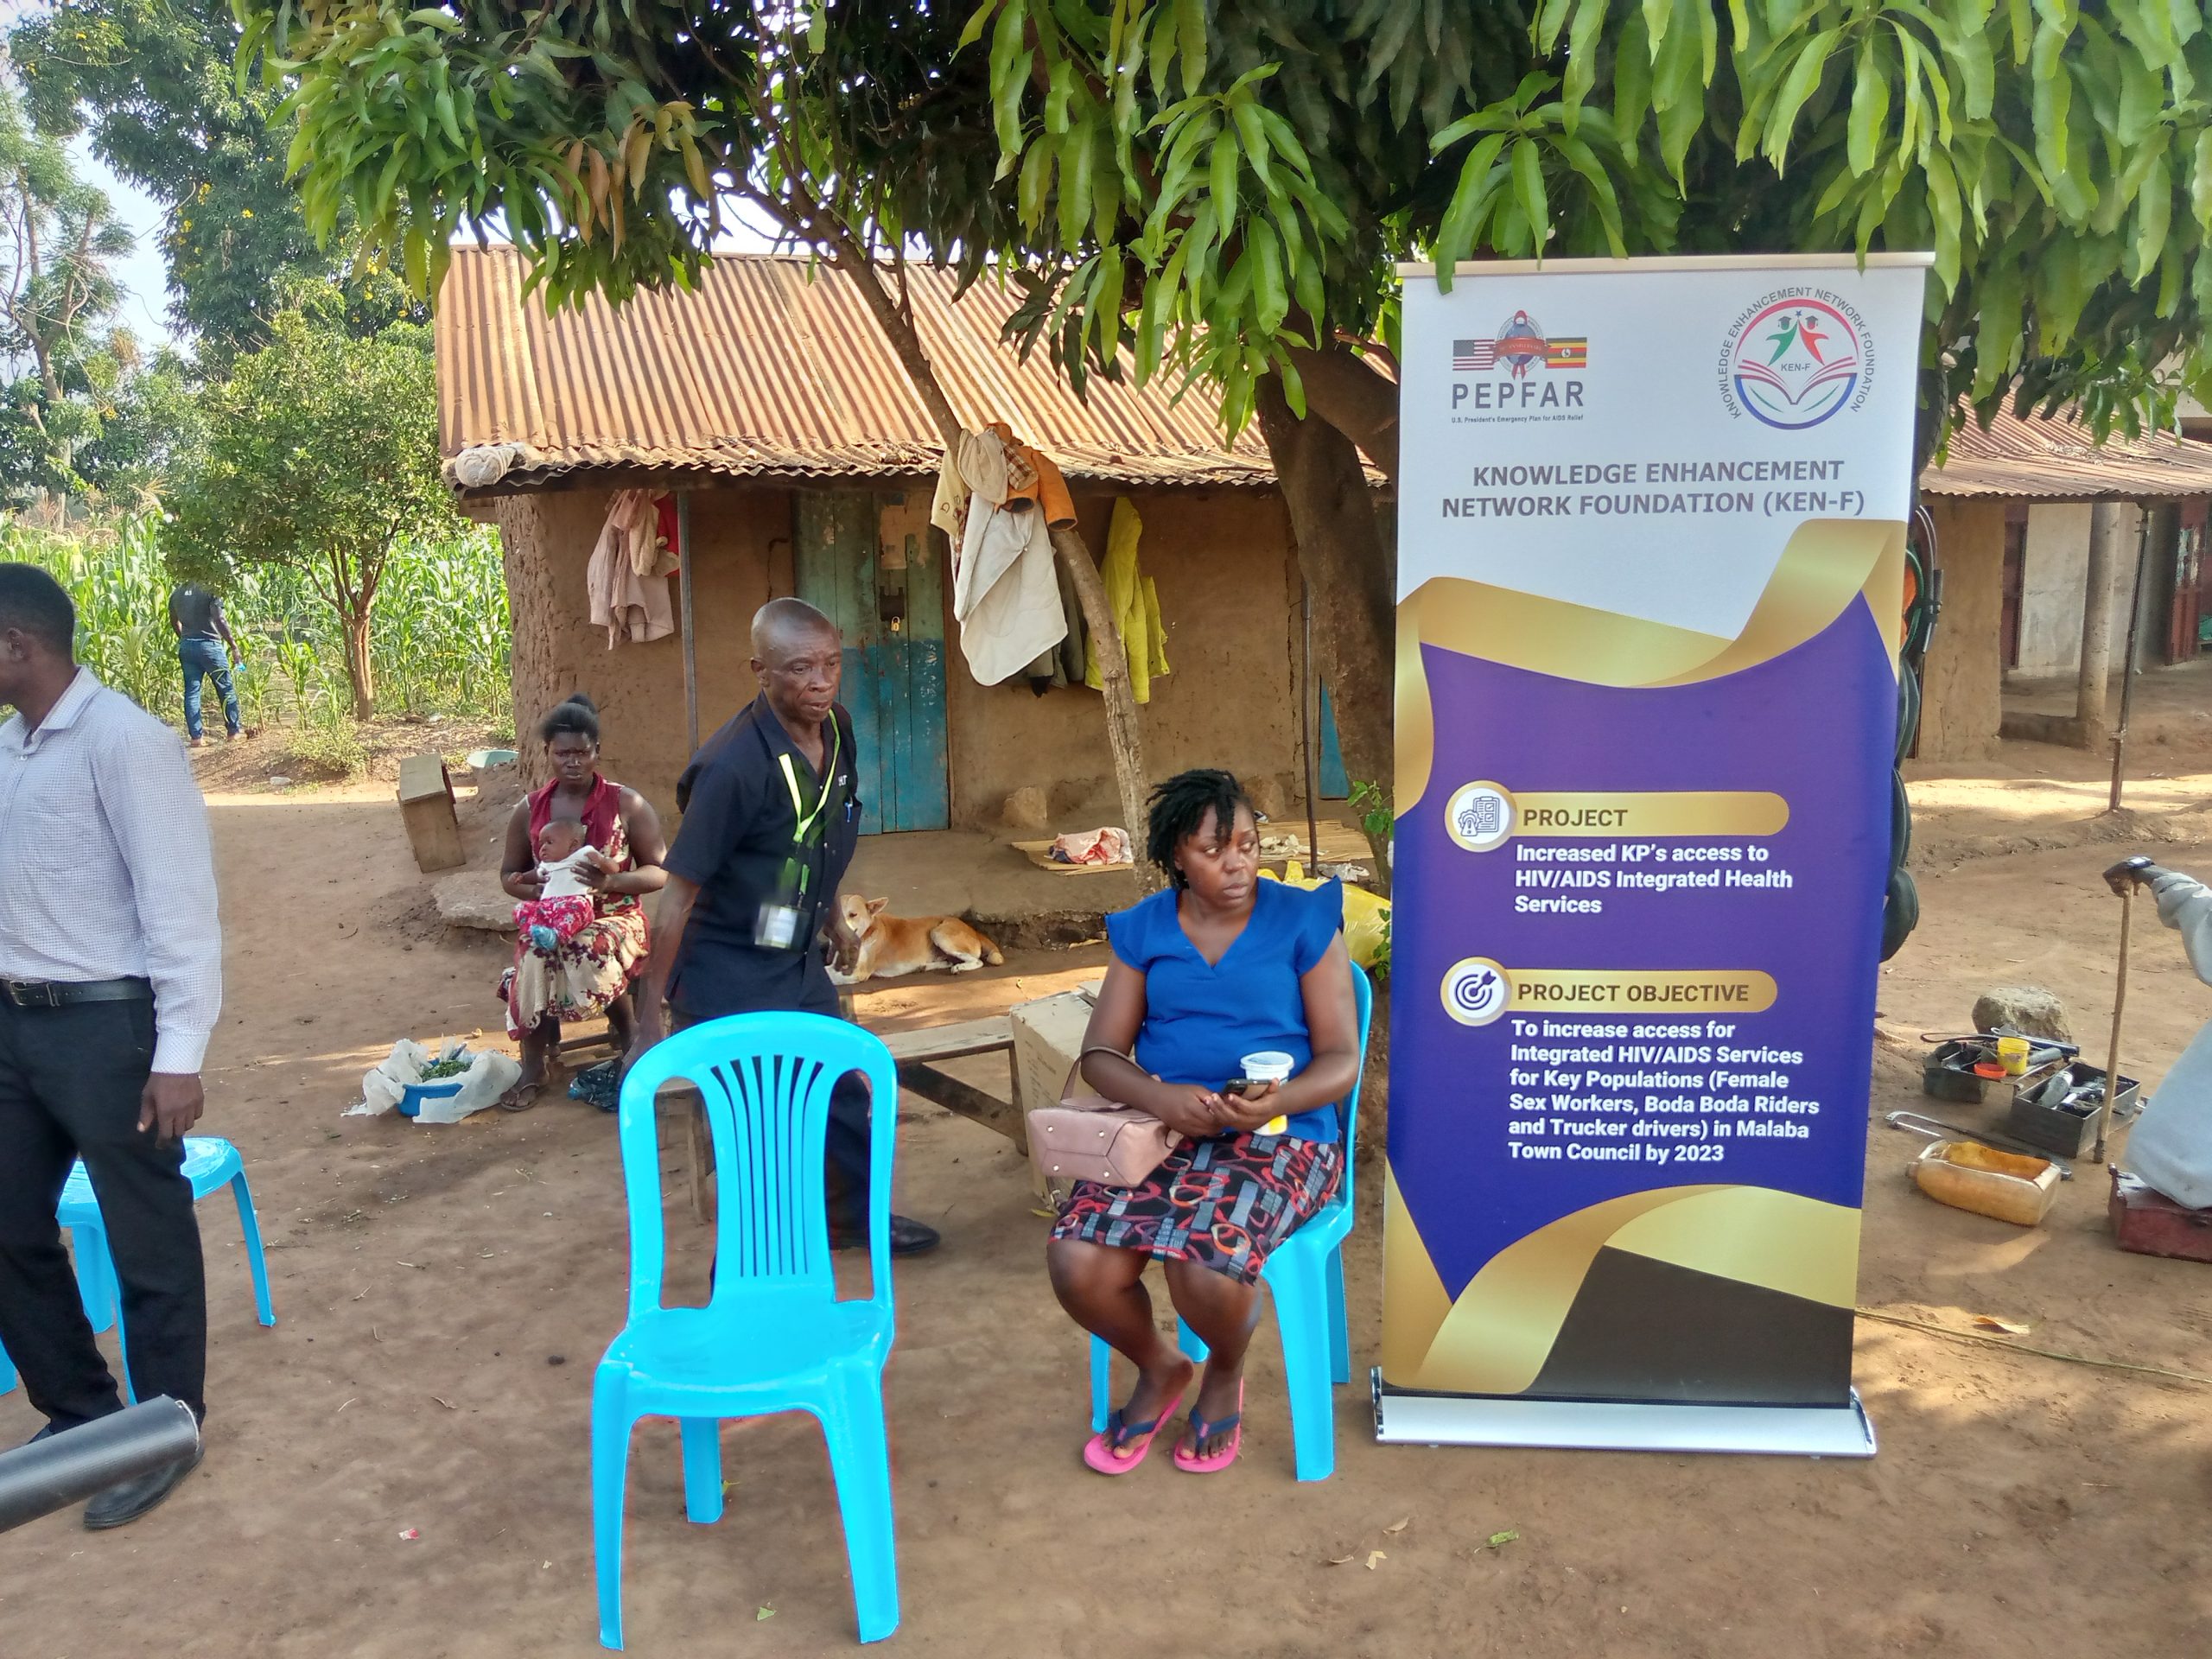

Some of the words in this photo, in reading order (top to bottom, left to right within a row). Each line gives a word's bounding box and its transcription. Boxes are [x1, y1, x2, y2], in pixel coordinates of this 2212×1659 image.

[1728, 287, 1812, 338] ENHANCEMENT
[1815, 289, 1866, 331] NETWORK
[1718, 340, 1741, 419] KNOWLEDGE
[1850, 332, 1874, 412] FOUNDATION
[1452, 380, 1584, 410] PEPFAR
[1473, 463, 1637, 486] KNOWLEDGE
[1645, 460, 1845, 483] ENHANCEMENT
[1442, 495, 1572, 518] NETWORK
[1580, 492, 1754, 515] FOUNDATION
[1763, 490, 1865, 518] (KEN-F)
[1523, 809, 1629, 827] PROJECT
[1516, 843, 1617, 862] Increased
[1621, 843, 1668, 862] KP's
[1671, 847, 1743, 861] access
[1746, 844, 1770, 861] to
[1515, 869, 1611, 888] HIV/AIDS
[1616, 868, 1720, 892] Integrated
[1725, 869, 1793, 888] Health
[1514, 894, 1602, 913] Services
[1517, 983, 1621, 1001] PROJECT
[1626, 984, 1750, 1002] OBJECTIVE
[1510, 1019, 1539, 1037] To
[1542, 1019, 1629, 1039] increase
[1632, 1025, 1702, 1039] access
[1706, 1020, 1736, 1039] for
[1510, 1044, 1614, 1066] Integrated
[1618, 1046, 1712, 1065] HIV/AIDS
[1716, 1046, 1803, 1065] Services
[1509, 1067, 1540, 1086] for
[1543, 1069, 1582, 1091] Key
[1586, 1070, 1704, 1091] Populations
[1708, 1070, 1789, 1092] (Female
[1509, 1093, 1547, 1111] Sex
[1551, 1094, 1639, 1116] Workers,
[1644, 1095, 1695, 1113] Boda
[1700, 1094, 1750, 1113] Boda
[1754, 1095, 1820, 1115] Riders
[1508, 1117, 1546, 1135] and
[1549, 1118, 1628, 1136] Trucker
[1631, 1119, 1708, 1141] drivers)
[1713, 1119, 1732, 1137] in
[1736, 1119, 1809, 1139] Malaba
[1507, 1141, 1562, 1160] Town
[1566, 1142, 1641, 1161] Council
[1645, 1143, 1670, 1166] by
[1674, 1144, 1725, 1161] 2023
